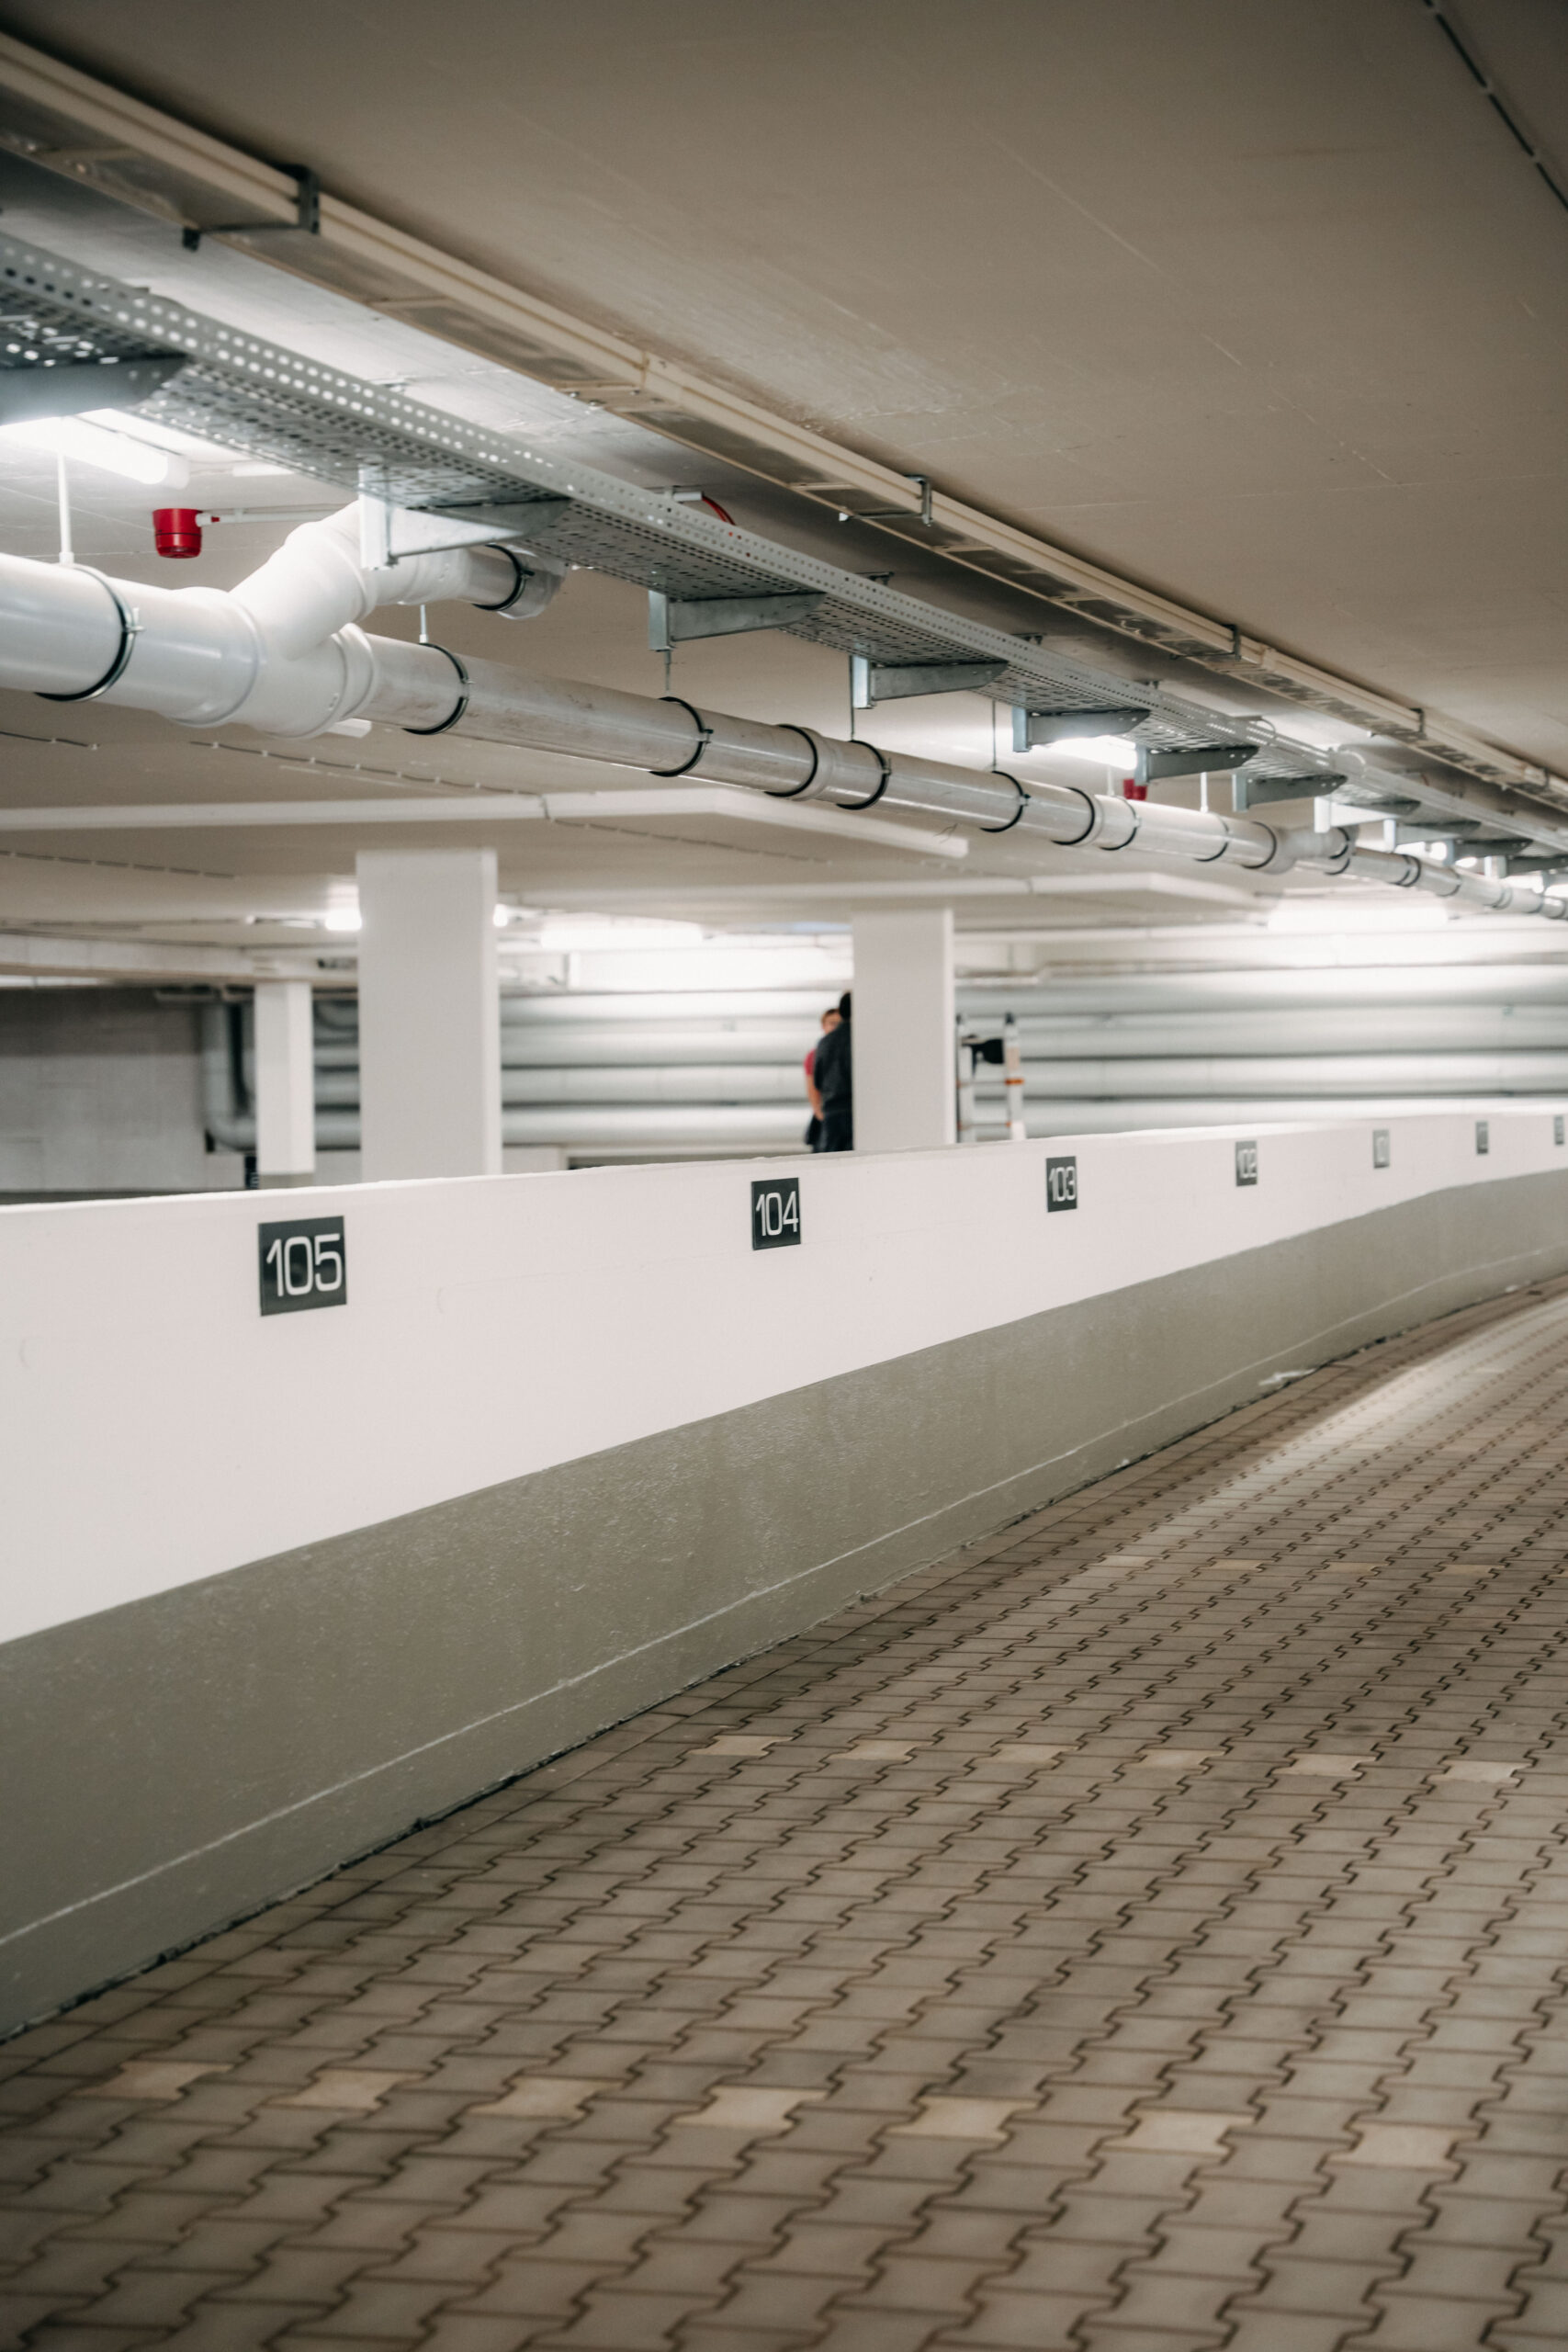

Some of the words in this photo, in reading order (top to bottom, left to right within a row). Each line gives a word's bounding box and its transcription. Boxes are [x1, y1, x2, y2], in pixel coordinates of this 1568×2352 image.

[1049, 1166, 1077, 1203] 103
[756, 1191, 798, 1236] 104
[266, 1233, 342, 1296] 105
